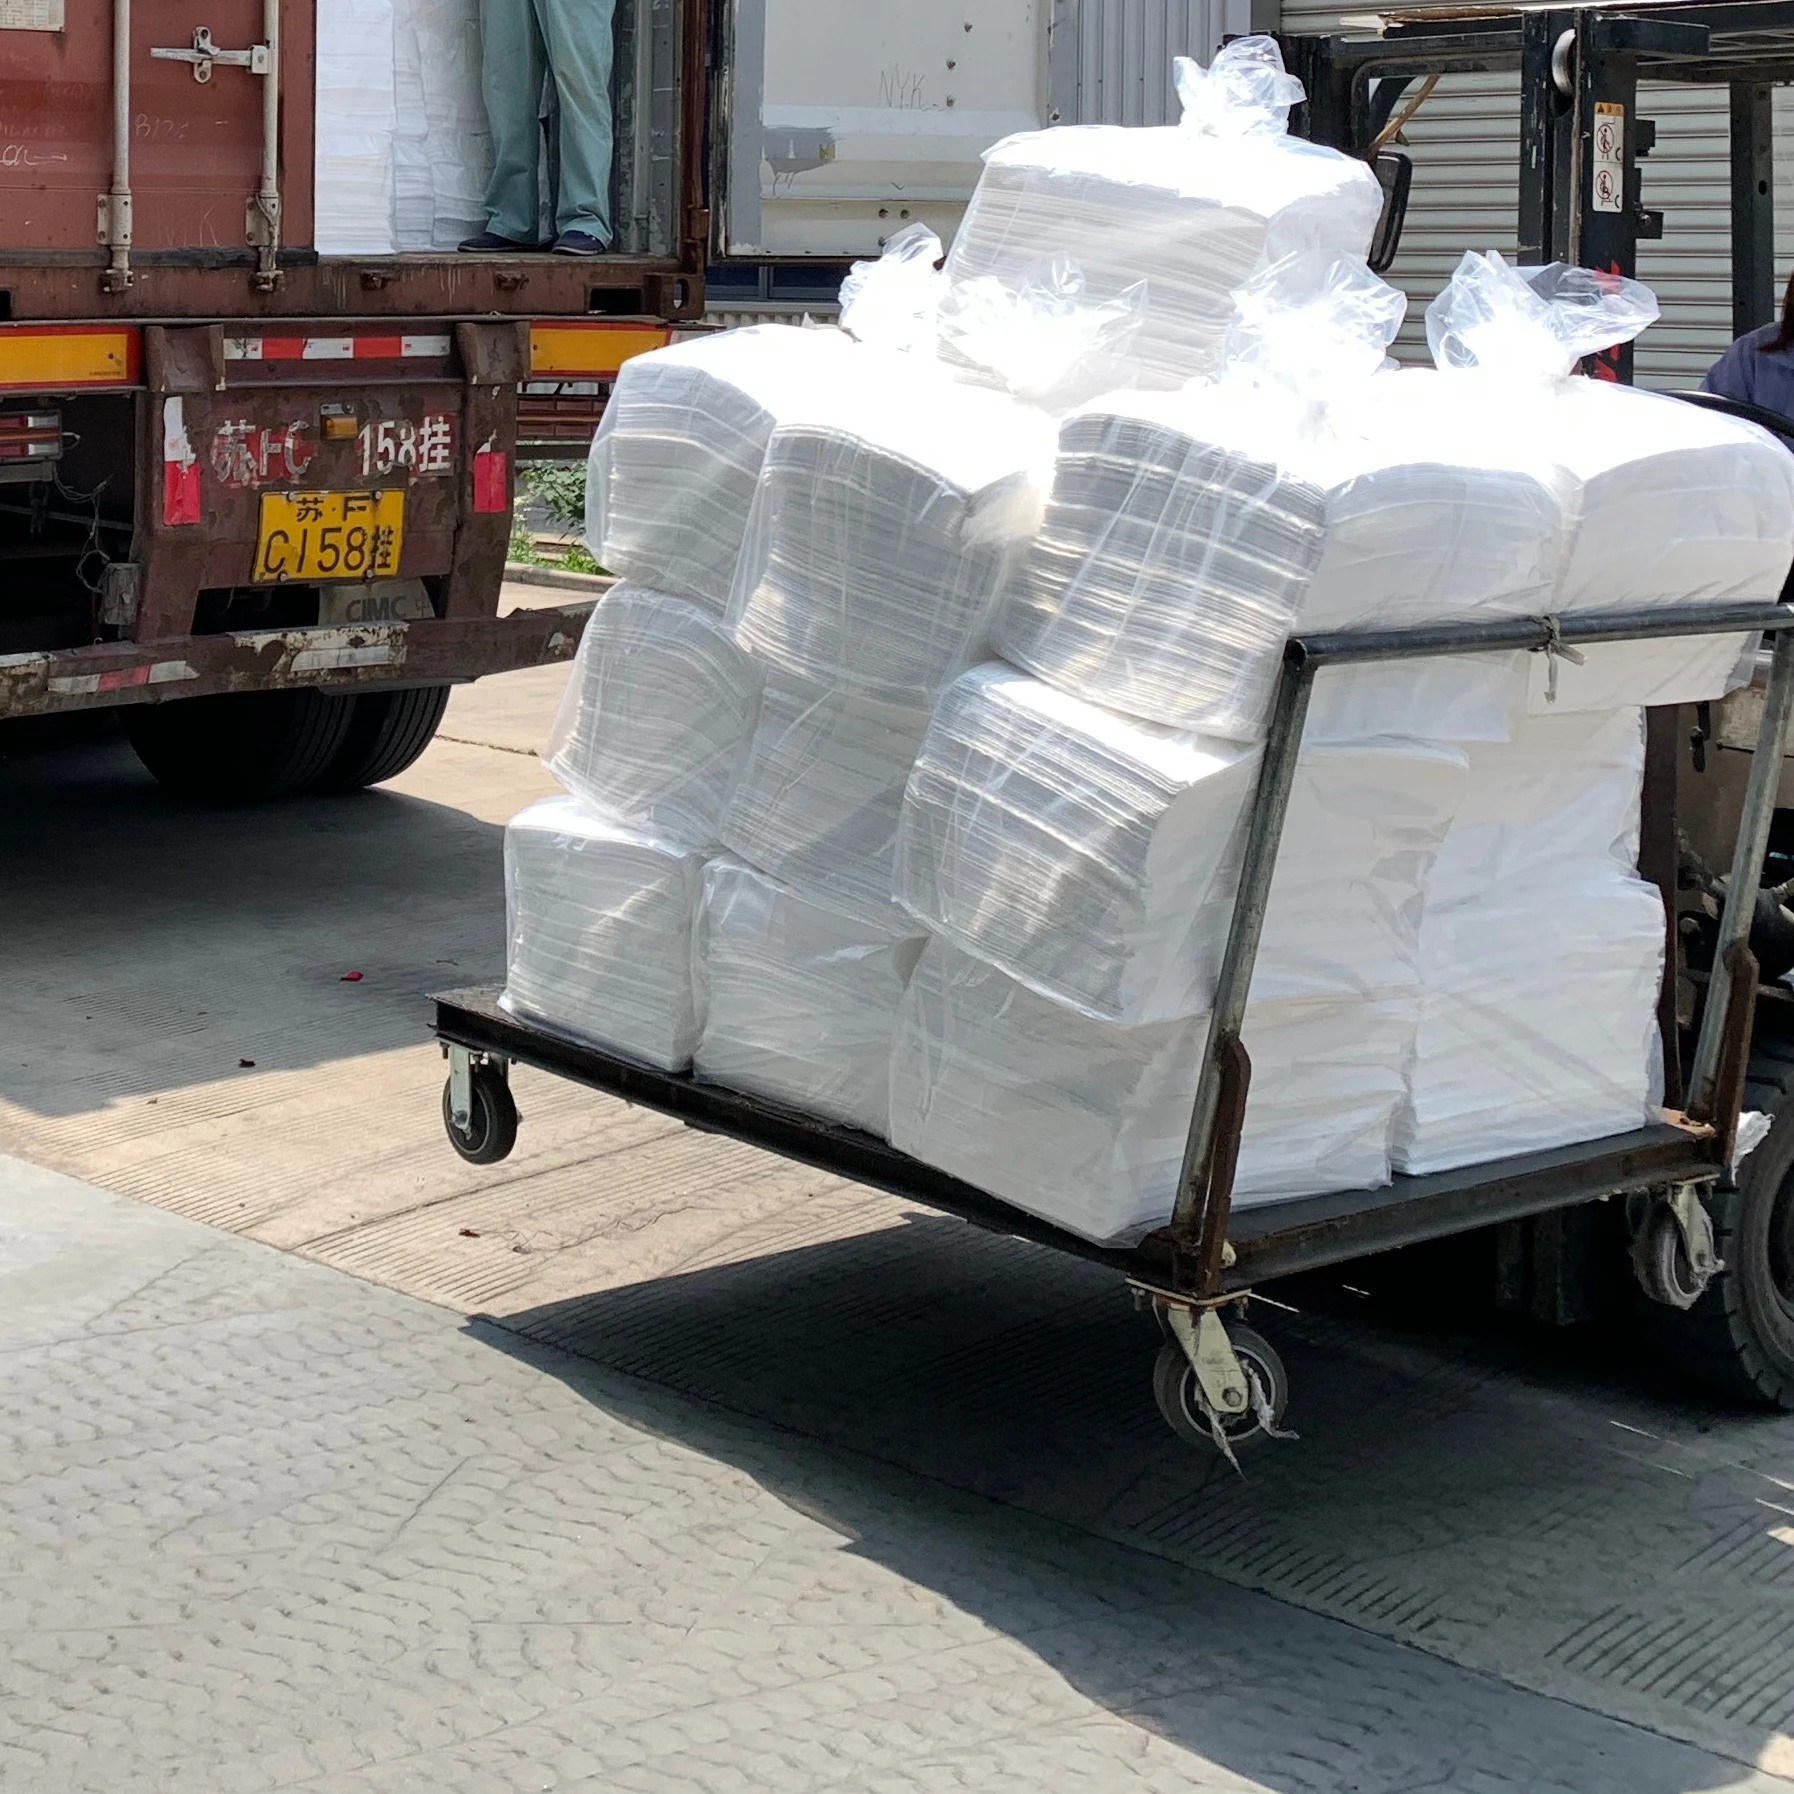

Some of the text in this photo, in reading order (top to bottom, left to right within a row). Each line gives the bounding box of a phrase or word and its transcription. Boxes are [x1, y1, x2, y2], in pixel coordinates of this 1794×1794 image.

[359, 415, 451, 477] 158挂
[263, 524, 394, 574] C158挂
[345, 595, 407, 622] CIMC
